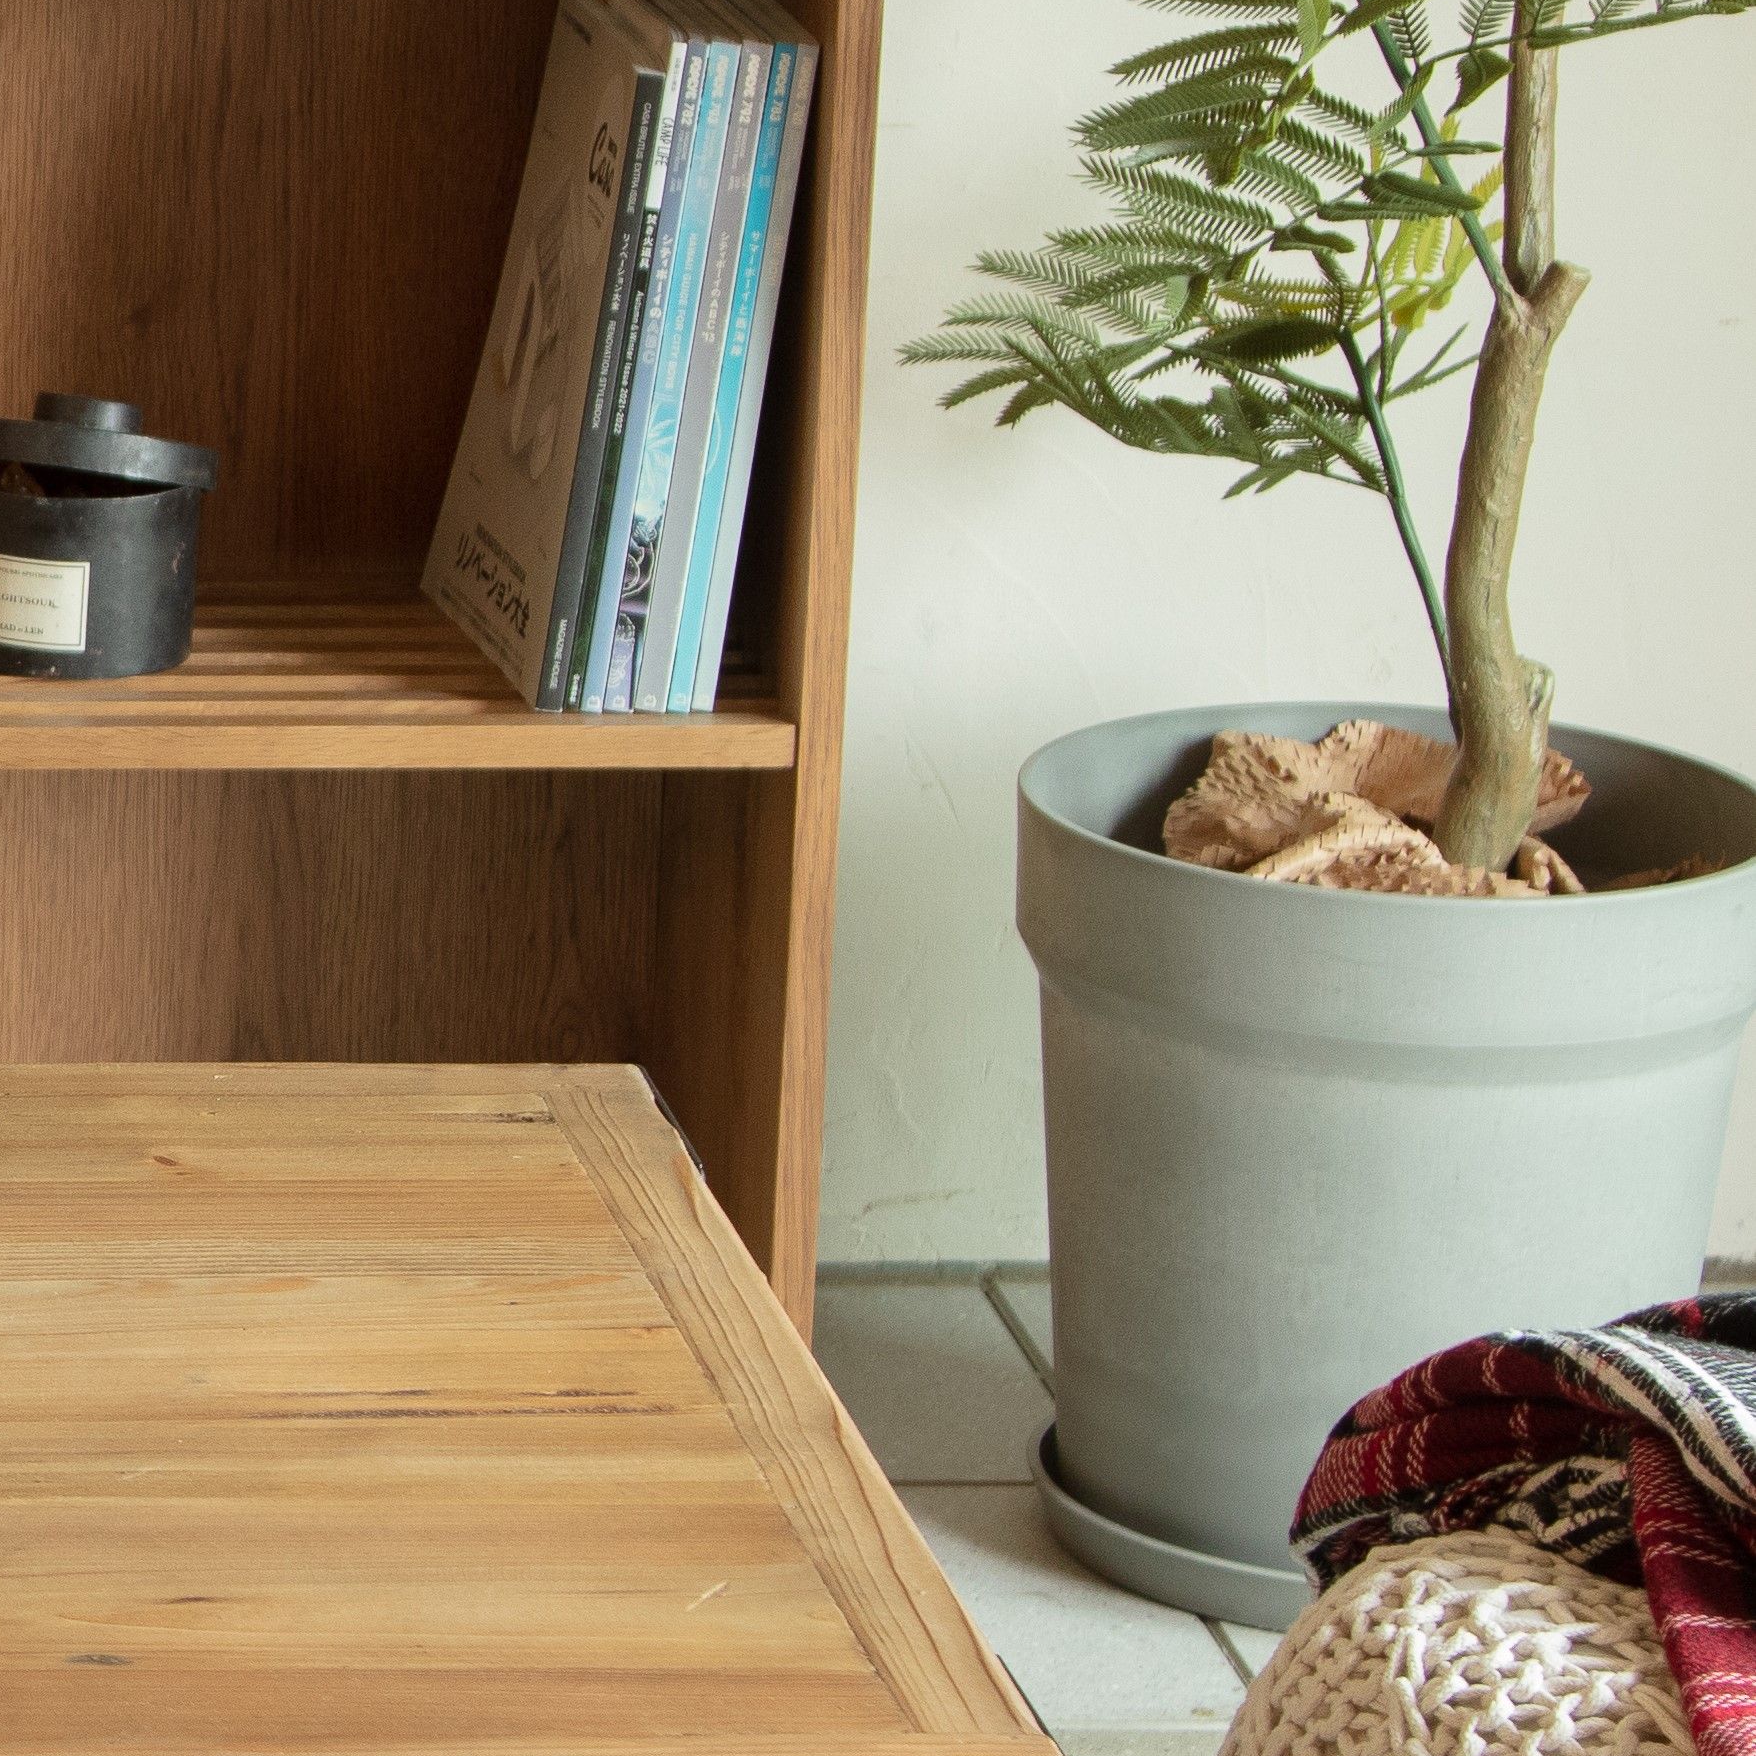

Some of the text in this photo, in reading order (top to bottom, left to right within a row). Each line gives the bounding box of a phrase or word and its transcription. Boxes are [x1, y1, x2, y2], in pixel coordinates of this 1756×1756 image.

[680, 100, 696, 126] 782
[738, 98, 754, 124] 792
[626, 101, 652, 214] CASA BRUTUS EXTRA ISSUE
[655, 116, 675, 166] CAMP LIFE
[630, 290, 645, 323] Autumn
[625, 330, 638, 360] Winter
[591, 319, 616, 429] RENOVATION STYLEBOOK
[620, 361, 633, 385] Issue
[612, 387, 628, 436] 2021-2022
[549, 618, 567, 689] MAGAZINE HOUSE
